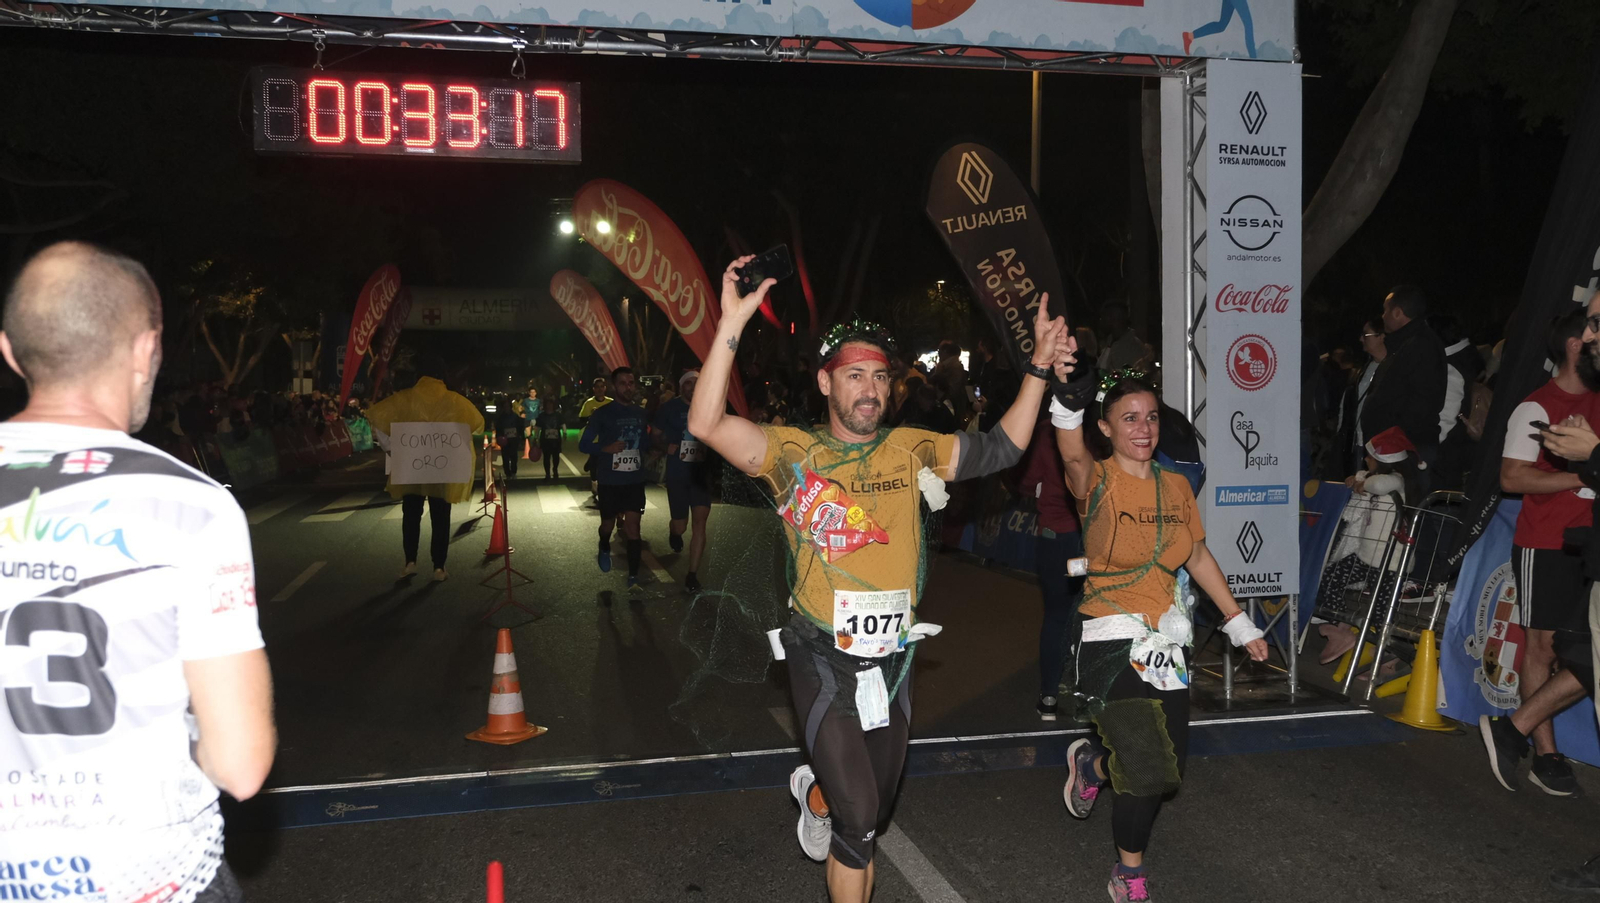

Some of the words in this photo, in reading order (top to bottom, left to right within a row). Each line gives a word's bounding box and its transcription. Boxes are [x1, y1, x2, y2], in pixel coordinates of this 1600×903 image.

[308, 79, 566, 149] 00:33:17
[1218, 143, 1287, 157] RENAULT
[1218, 156, 1240, 166] SYRSA
[1241, 157, 1287, 168] AUTOMOCION
[1220, 217, 1284, 229] NISSAN
[1226, 253, 1282, 263] andalmotor.es
[1215, 283, 1294, 314] Coca-Cola
[353, 270, 398, 355] Coca-Cola
[400, 431, 462, 450] COMPRO
[1245, 430, 1279, 470] Paquita
[412, 454, 449, 471] ORO
[617, 456, 639, 464] 1076
[850, 478, 909, 494] LURBEL
[792, 480, 824, 526] Grefusa
[1218, 489, 1267, 504] Almericar
[0, 560, 77, 582] unato
[1227, 572, 1283, 585] ENAULT
[1238, 585, 1283, 594] AUTOMOCION
[847, 612, 904, 635] 1077
[5, 601, 117, 736] 3
